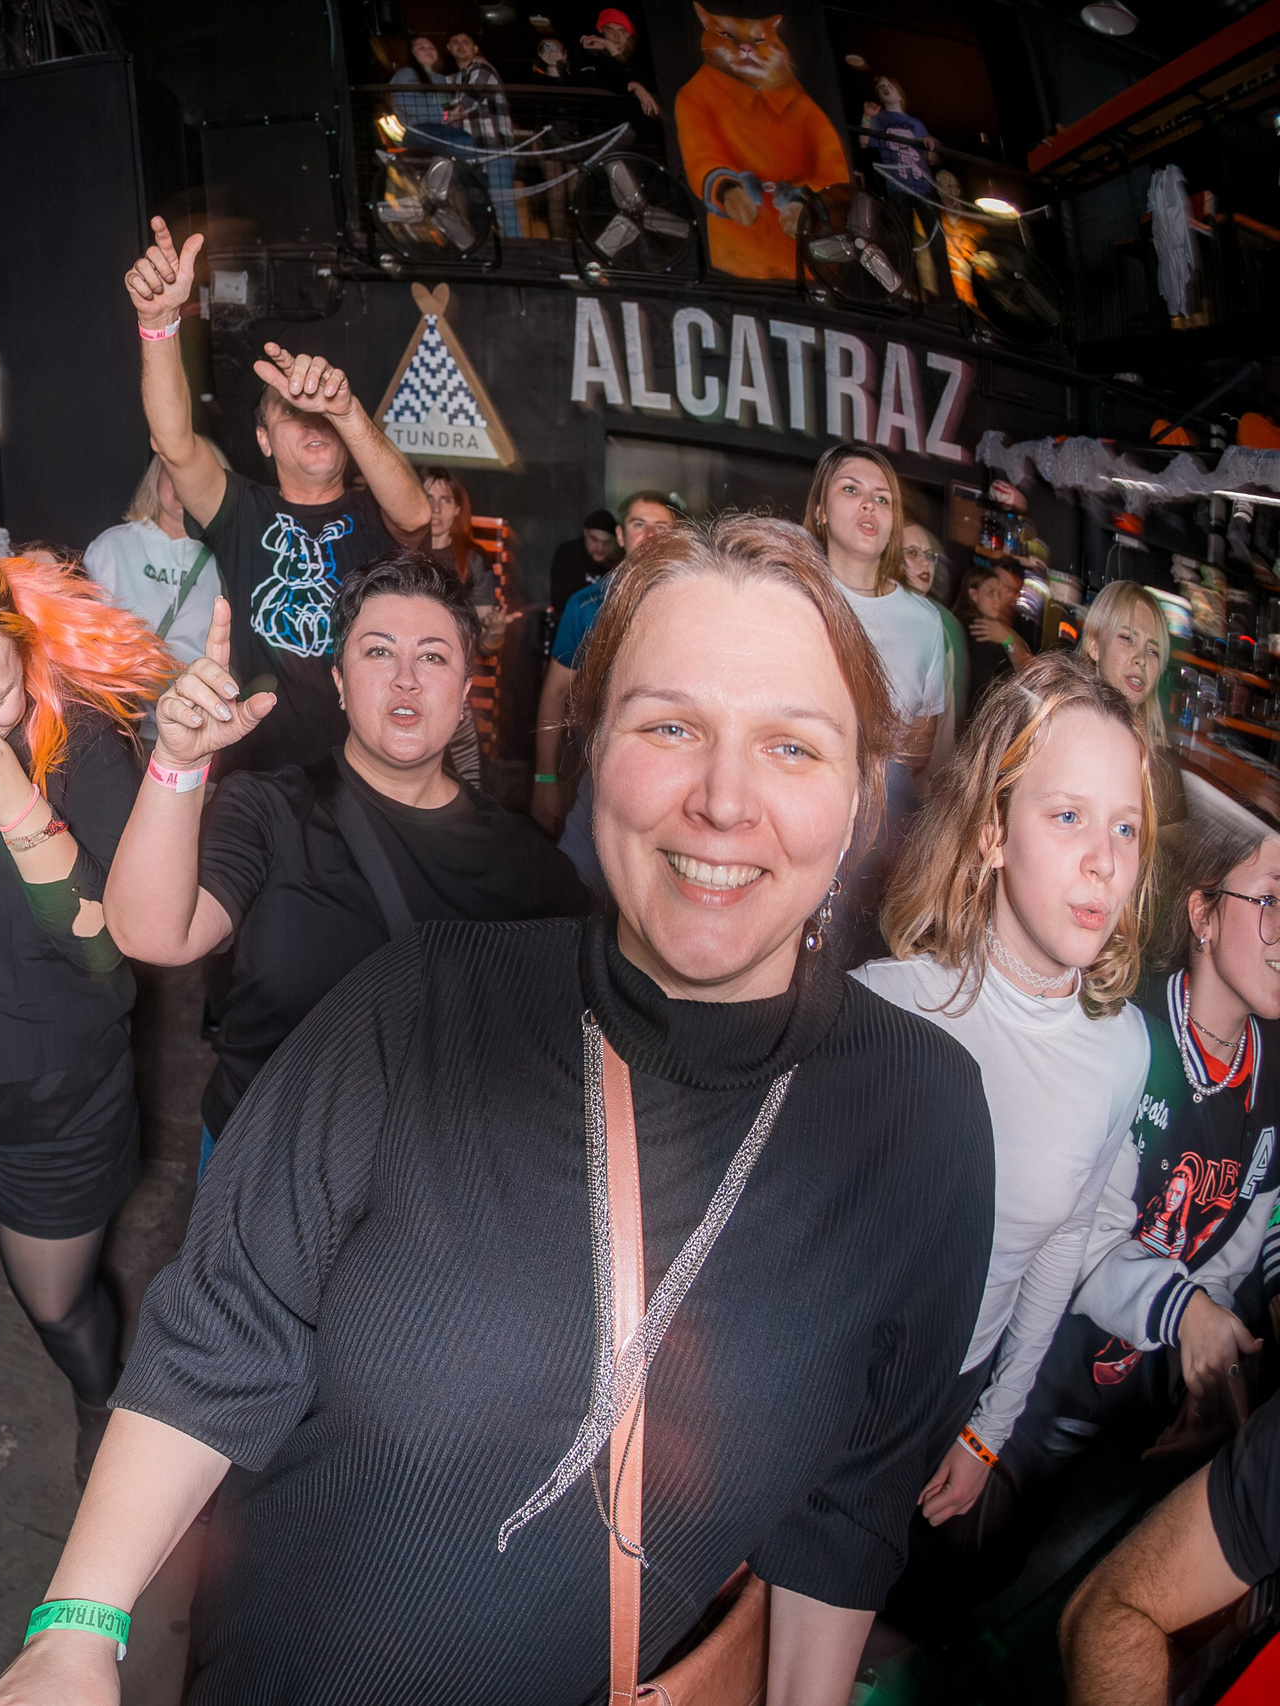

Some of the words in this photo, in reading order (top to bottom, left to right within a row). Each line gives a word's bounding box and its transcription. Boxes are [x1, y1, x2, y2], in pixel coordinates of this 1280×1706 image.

[571, 297, 963, 461] ALCATRAZ
[393, 429, 479, 449] TUNDRA
[54, 1606, 129, 1637] ALCATRAZ
